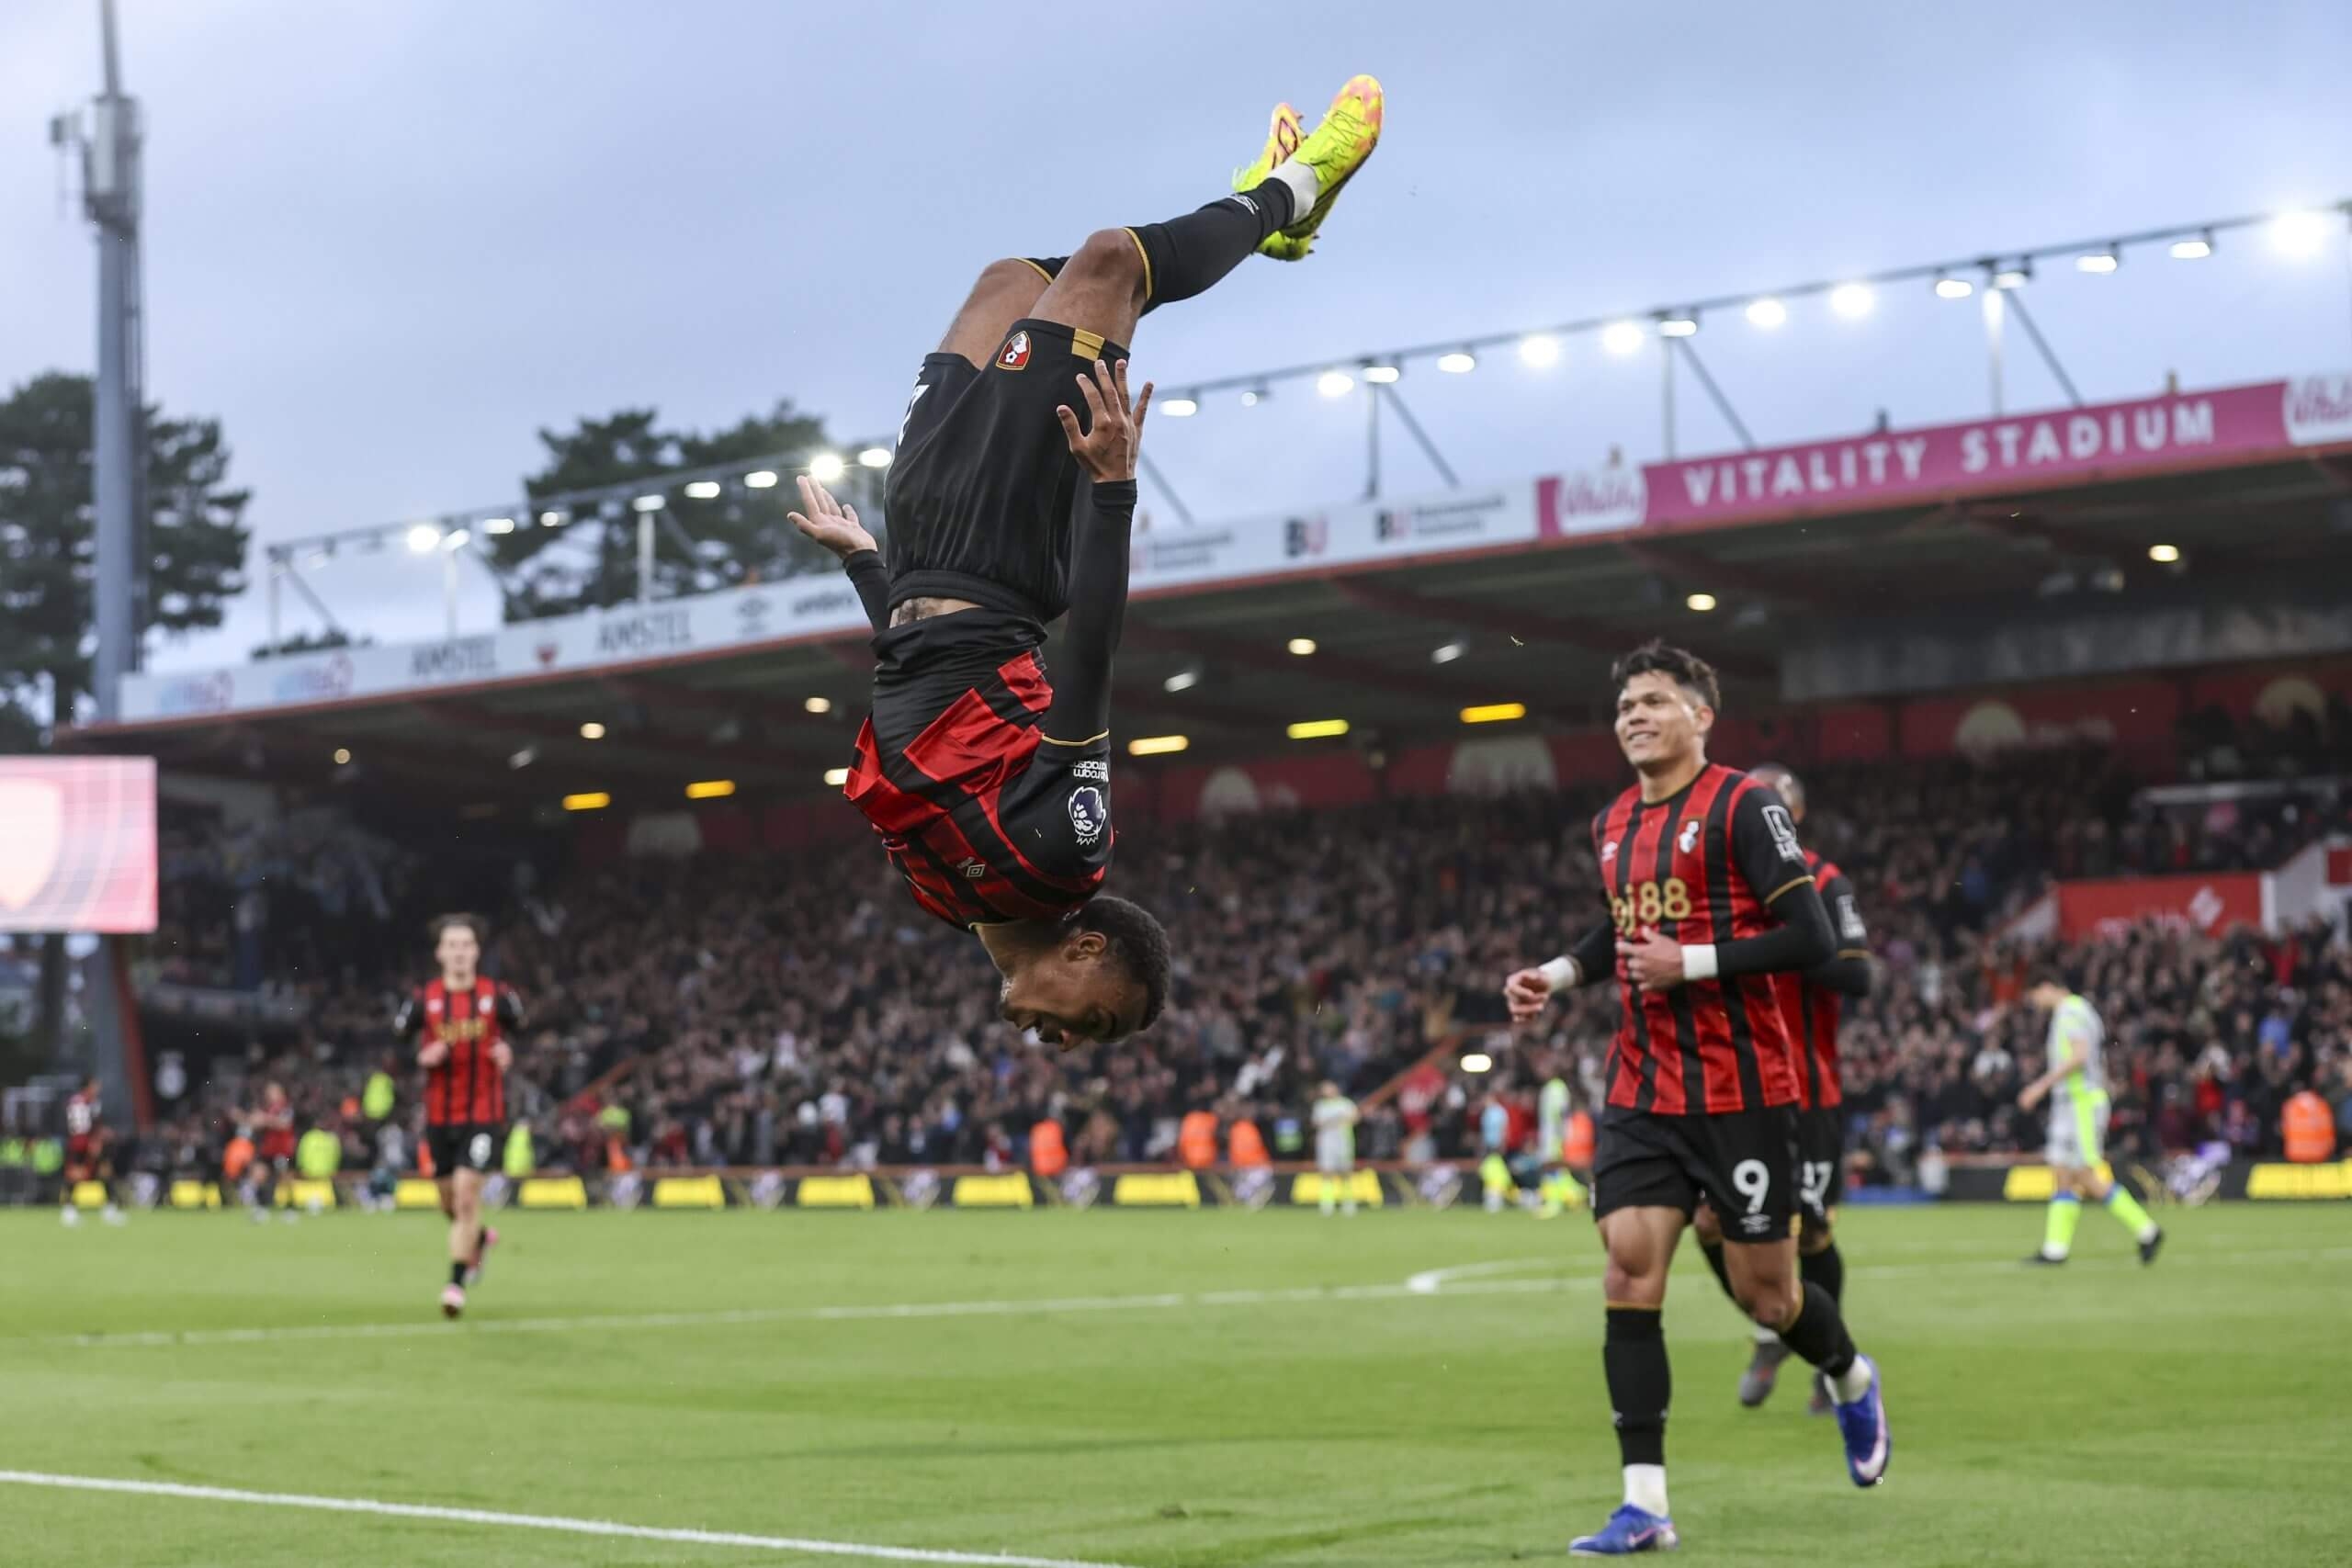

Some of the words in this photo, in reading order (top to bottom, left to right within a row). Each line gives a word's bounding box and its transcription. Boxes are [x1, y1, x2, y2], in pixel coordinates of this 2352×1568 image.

[1683, 436, 1926, 507] VITALITY
[1960, 400, 2214, 474] STADIUM
[1733, 1158, 1770, 1213] 9
